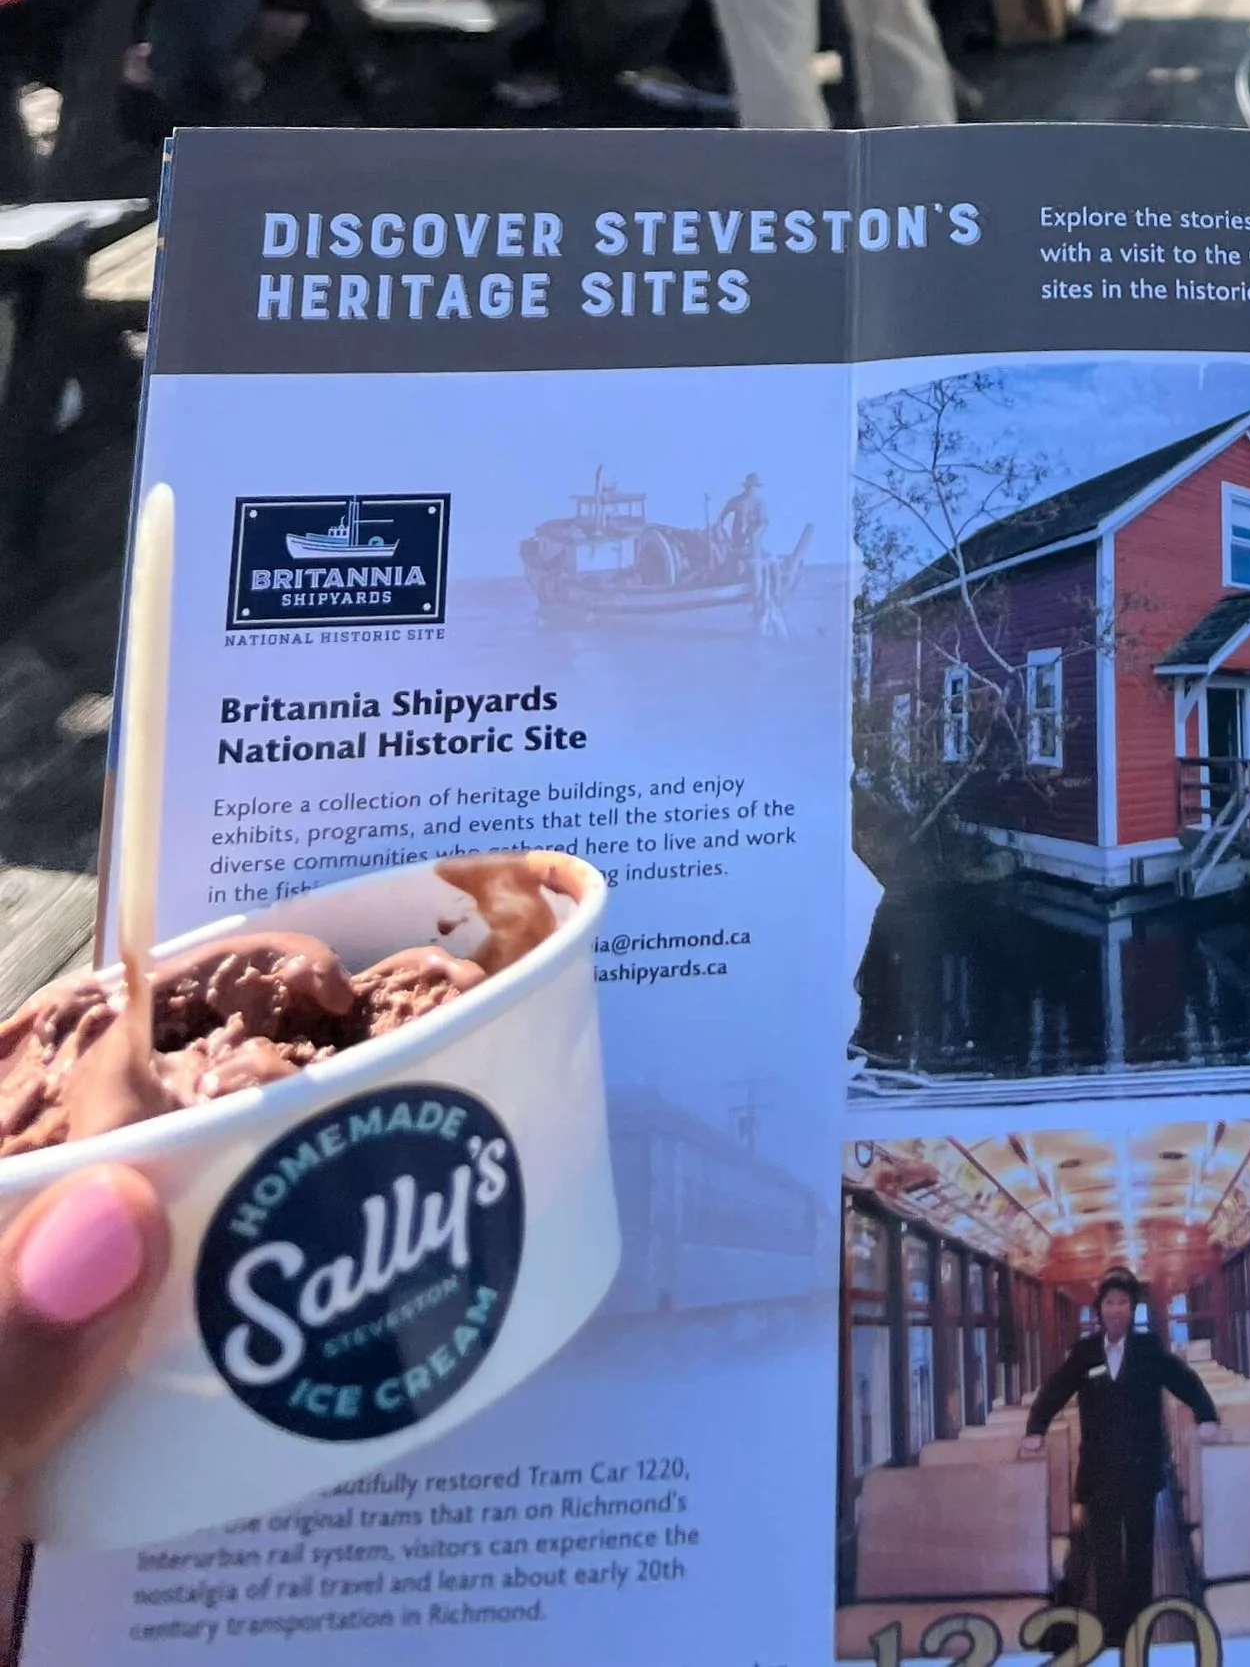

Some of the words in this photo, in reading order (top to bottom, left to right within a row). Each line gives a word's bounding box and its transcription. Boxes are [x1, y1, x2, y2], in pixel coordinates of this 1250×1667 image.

[261, 211, 563, 259] DISCOVER
[594, 201, 981, 257] STEVESTON'S
[1040, 207, 1128, 232] Explore
[1135, 207, 1172, 227] the
[1040, 241, 1091, 263] with
[1100, 247, 1113, 264] a
[1120, 243, 1165, 263] visit
[1173, 245, 1197, 264] to
[1205, 244, 1241, 265] the
[257, 272, 550, 320] HERITAGE
[580, 268, 752, 317] SITES
[1041, 279, 1093, 299] sites
[1102, 279, 1122, 299] in
[1131, 278, 1168, 299] the
[251, 565, 426, 591] BRITANNIA
[281, 591, 392, 607] SHIPYARDS
[224, 632, 314, 647] NATIONAL
[320, 629, 401, 643] HISTORIC
[407, 628, 445, 641] SITE
[220, 691, 381, 724] Britannia
[391, 684, 559, 723] Shipyards
[217, 731, 367, 765] National
[377, 726, 514, 758] Historic
[523, 723, 588, 752] Site
[213, 797, 293, 821] Explore
[300, 801, 310, 813] a
[318, 791, 421, 812] collection
[429, 787, 451, 806] of
[457, 786, 541, 808] heritage
[548, 781, 642, 803] buildings,
[650, 777, 685, 796] and
[692, 775, 745, 798] enjoy
[212, 825, 300, 845] exhibits,
[307, 821, 415, 847] programs,
[423, 816, 461, 835] and
[469, 813, 534, 833] events
[542, 810, 582, 830] that
[589, 807, 618, 827] tell
[626, 807, 657, 825] the
[664, 804, 730, 823] stories
[737, 800, 758, 819] of
[764, 800, 795, 817] the
[210, 855, 286, 875] diverse
[294, 848, 427, 870] communities
[585, 837, 629, 855] here
[637, 836, 657, 852] to
[664, 833, 696, 851] live
[703, 829, 739, 848] and
[746, 827, 797, 846] work
[207, 886, 226, 904] in
[234, 884, 268, 901] the
[626, 861, 728, 882] industries.
[229, 1101, 468, 1239] HOMEMADE
[224, 1135, 509, 1387] Sally's
[322, 1274, 458, 1358] STEVESTON
[289, 1379, 361, 1420] ICE
[375, 1286, 497, 1411] CREAM
[425, 1467, 520, 1492] restored
[529, 1465, 581, 1487] Tram
[591, 1461, 629, 1483] Car
[637, 1458, 690, 1482] 1220,
[268, 1507, 353, 1536] original
[360, 1510, 422, 1527] trams
[430, 1503, 473, 1526] that
[482, 1504, 518, 1522] ran
[525, 1502, 552, 1520] on
[561, 1490, 688, 1519] Richmond's
[402, 1537, 482, 1561] visitors
[490, 1537, 528, 1557] can
[535, 1528, 656, 1557] experience
[664, 1524, 699, 1546] the
[246, 1574, 272, 1599] of
[277, 1574, 312, 1598] rail
[321, 1572, 384, 1597] travel
[391, 1571, 431, 1595] and
[439, 1568, 494, 1592] learn
[502, 1566, 566, 1589] about
[574, 1561, 630, 1590] early
[637, 1556, 684, 1582] 20th
[401, 1606, 421, 1626] in
[429, 1599, 546, 1626] Richmond.
